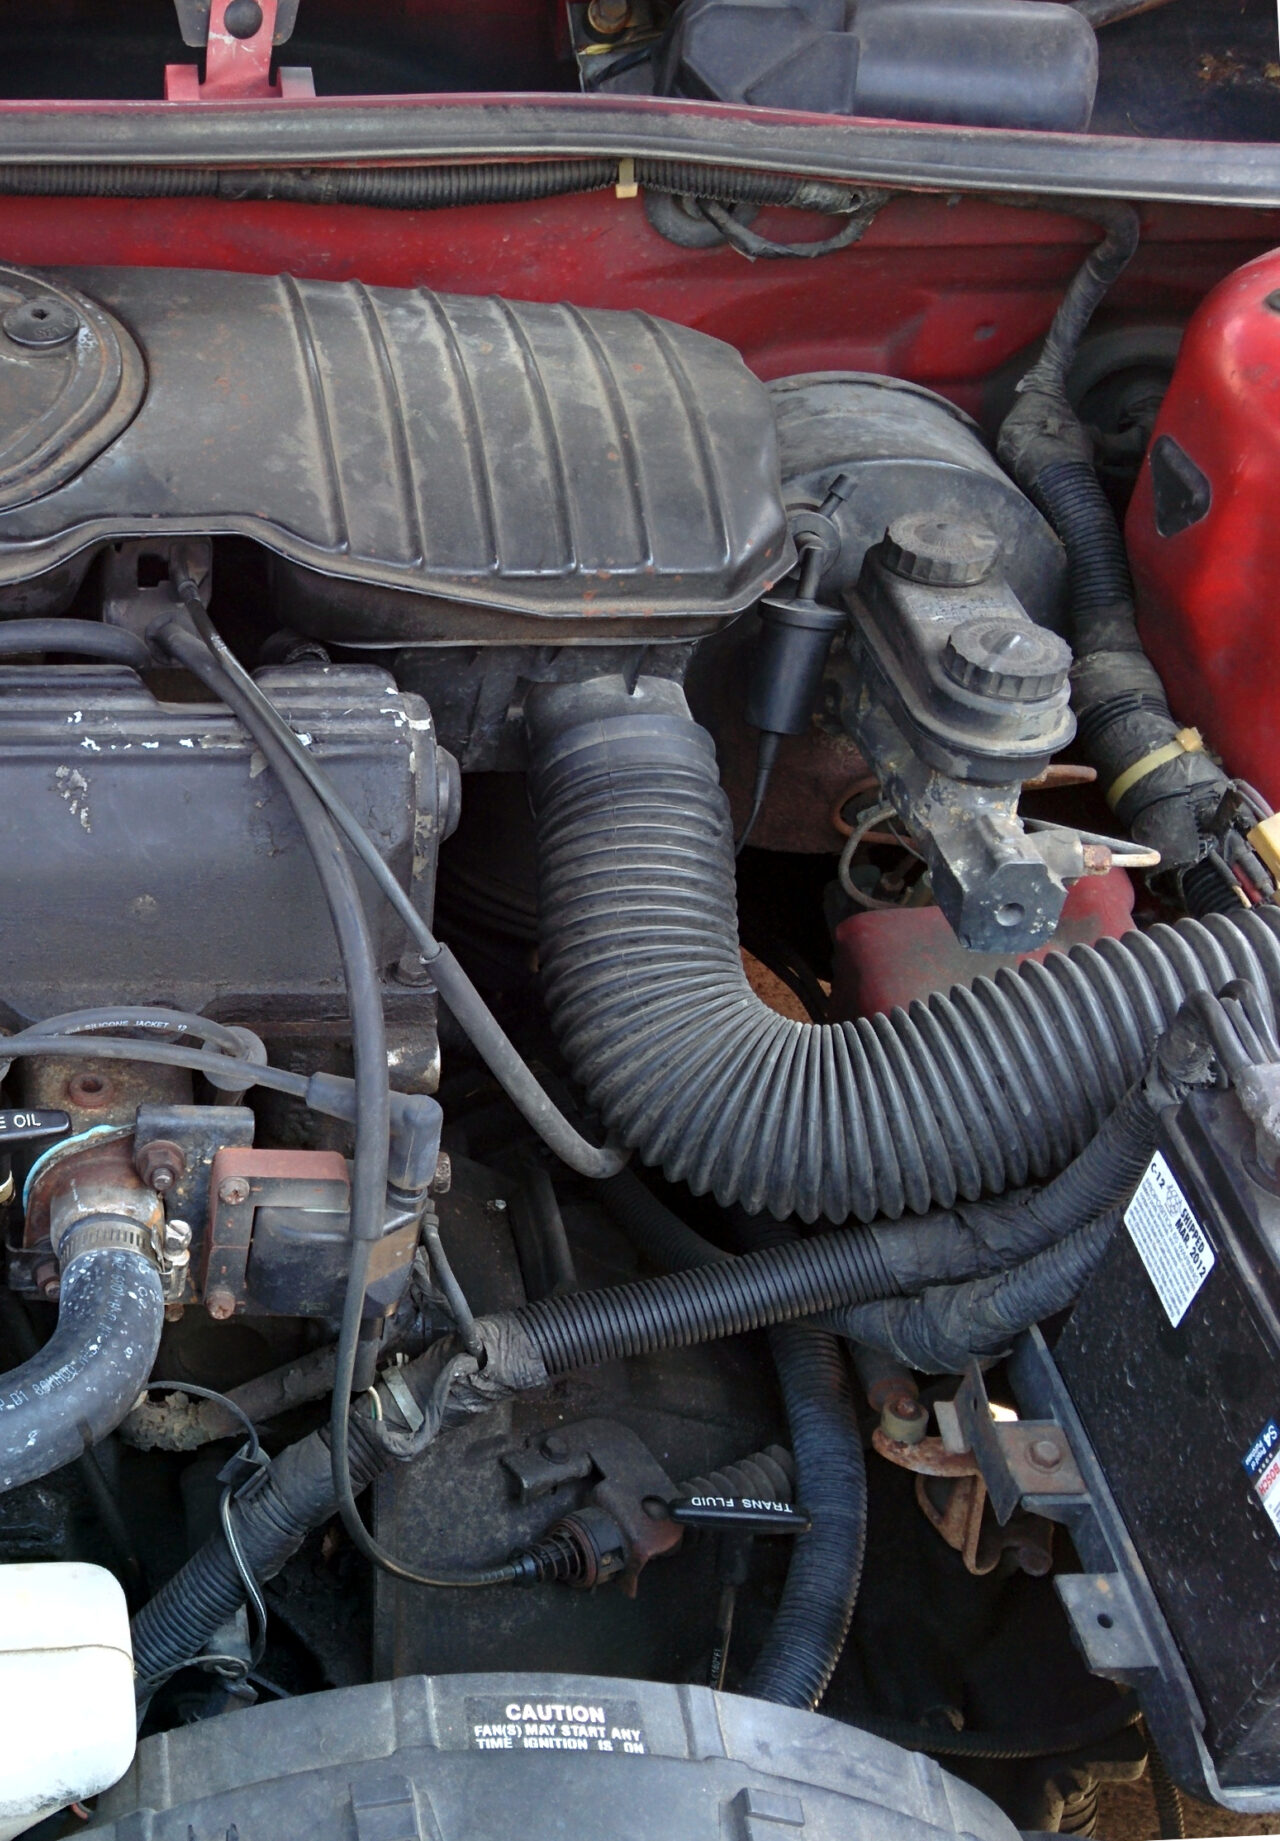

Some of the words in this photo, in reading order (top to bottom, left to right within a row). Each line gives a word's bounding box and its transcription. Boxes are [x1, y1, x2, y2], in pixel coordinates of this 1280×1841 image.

[84, 1020, 129, 1032] SILICONE
[135, 1020, 170, 1029] JACKET
[13, 1113, 42, 1128] OIL
[1150, 1162, 1166, 1190] C-12
[1180, 1208, 1205, 1253] SHIPPED
[1175, 1218, 1190, 1249] MAR.
[1189, 1247, 1206, 1278] 2012
[1263, 1425, 1278, 1447] S4
[1259, 1462, 1280, 1496] BOSCH
[691, 1496, 734, 1508] FLUID
[741, 1498, 793, 1513] TRANS
[505, 1703, 606, 1723] CAUTION
[474, 1725, 523, 1738] FAN(S)
[525, 1724, 557, 1736] MAY
[561, 1725, 606, 1739] START
[611, 1727, 641, 1742] ANY
[476, 1738, 514, 1750] TIME
[523, 1738, 589, 1751] IGNITION
[598, 1739, 614, 1752] IS
[624, 1741, 646, 1754] ON
